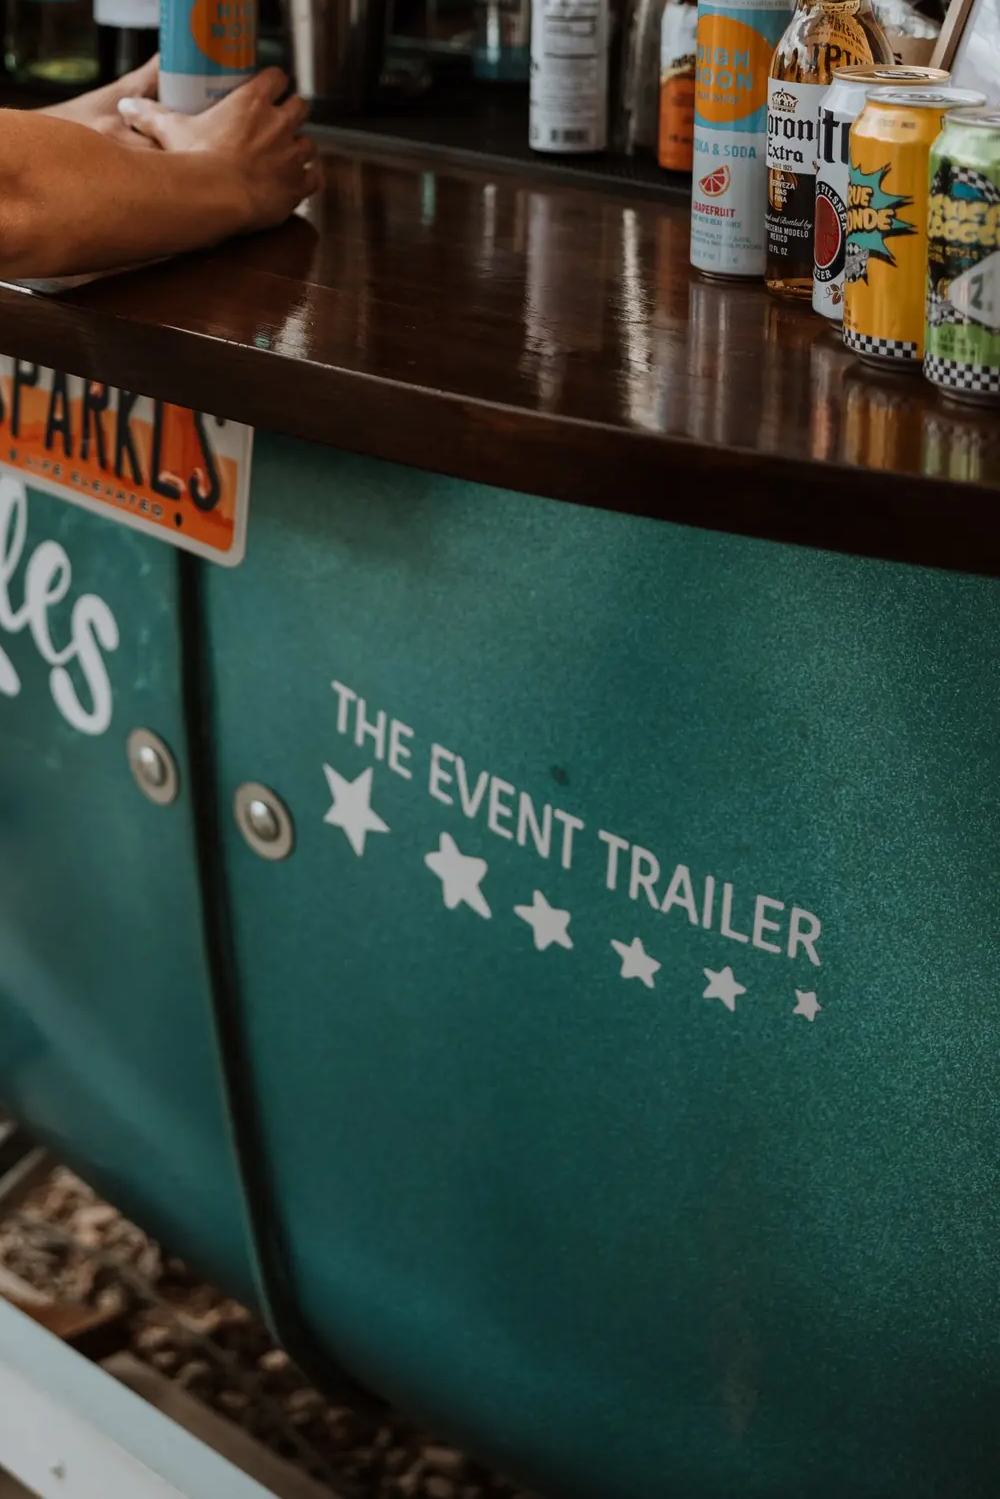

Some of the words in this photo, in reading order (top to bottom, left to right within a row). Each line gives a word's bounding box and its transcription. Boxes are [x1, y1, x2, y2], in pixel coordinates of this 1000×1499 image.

[767, 104, 818, 141] oron
[712, 143, 720, 156] &
[723, 145, 757, 159] SODA
[821, 184, 847, 231] PILSNER
[848, 185, 873, 208] RUE
[783, 227, 809, 238] MODELO
[847, 207, 895, 233] ONDE
[25, 451, 62, 479] LIFE
[70, 472, 164, 518] ELEVATED
[331, 680, 414, 780] THE
[428, 743, 584, 869] EVENT
[599, 829, 821, 966] TRAILER
